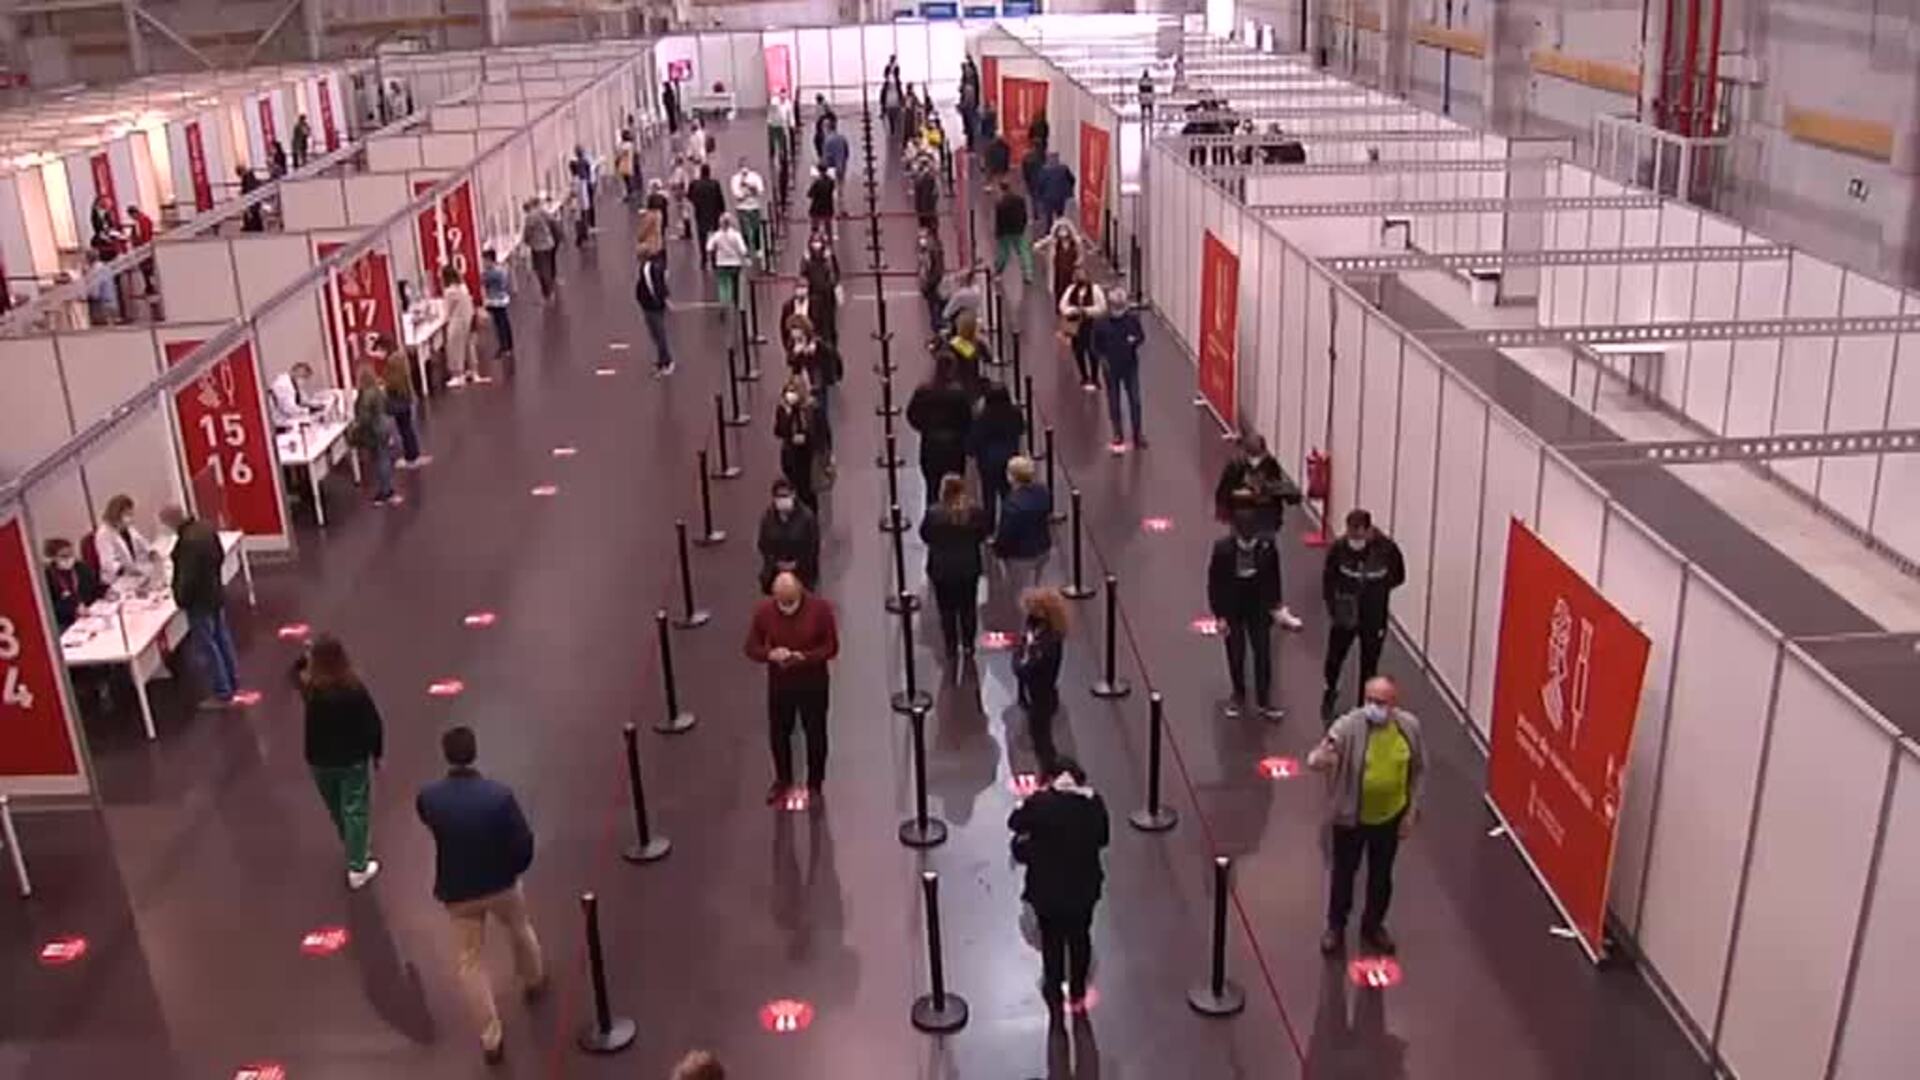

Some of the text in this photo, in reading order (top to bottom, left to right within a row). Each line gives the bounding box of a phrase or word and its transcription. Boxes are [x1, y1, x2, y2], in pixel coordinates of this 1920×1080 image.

[343, 298, 377, 328] 17
[199, 413, 246, 447] 15
[207, 451, 254, 485] 16
[3, 665, 34, 709] 4
